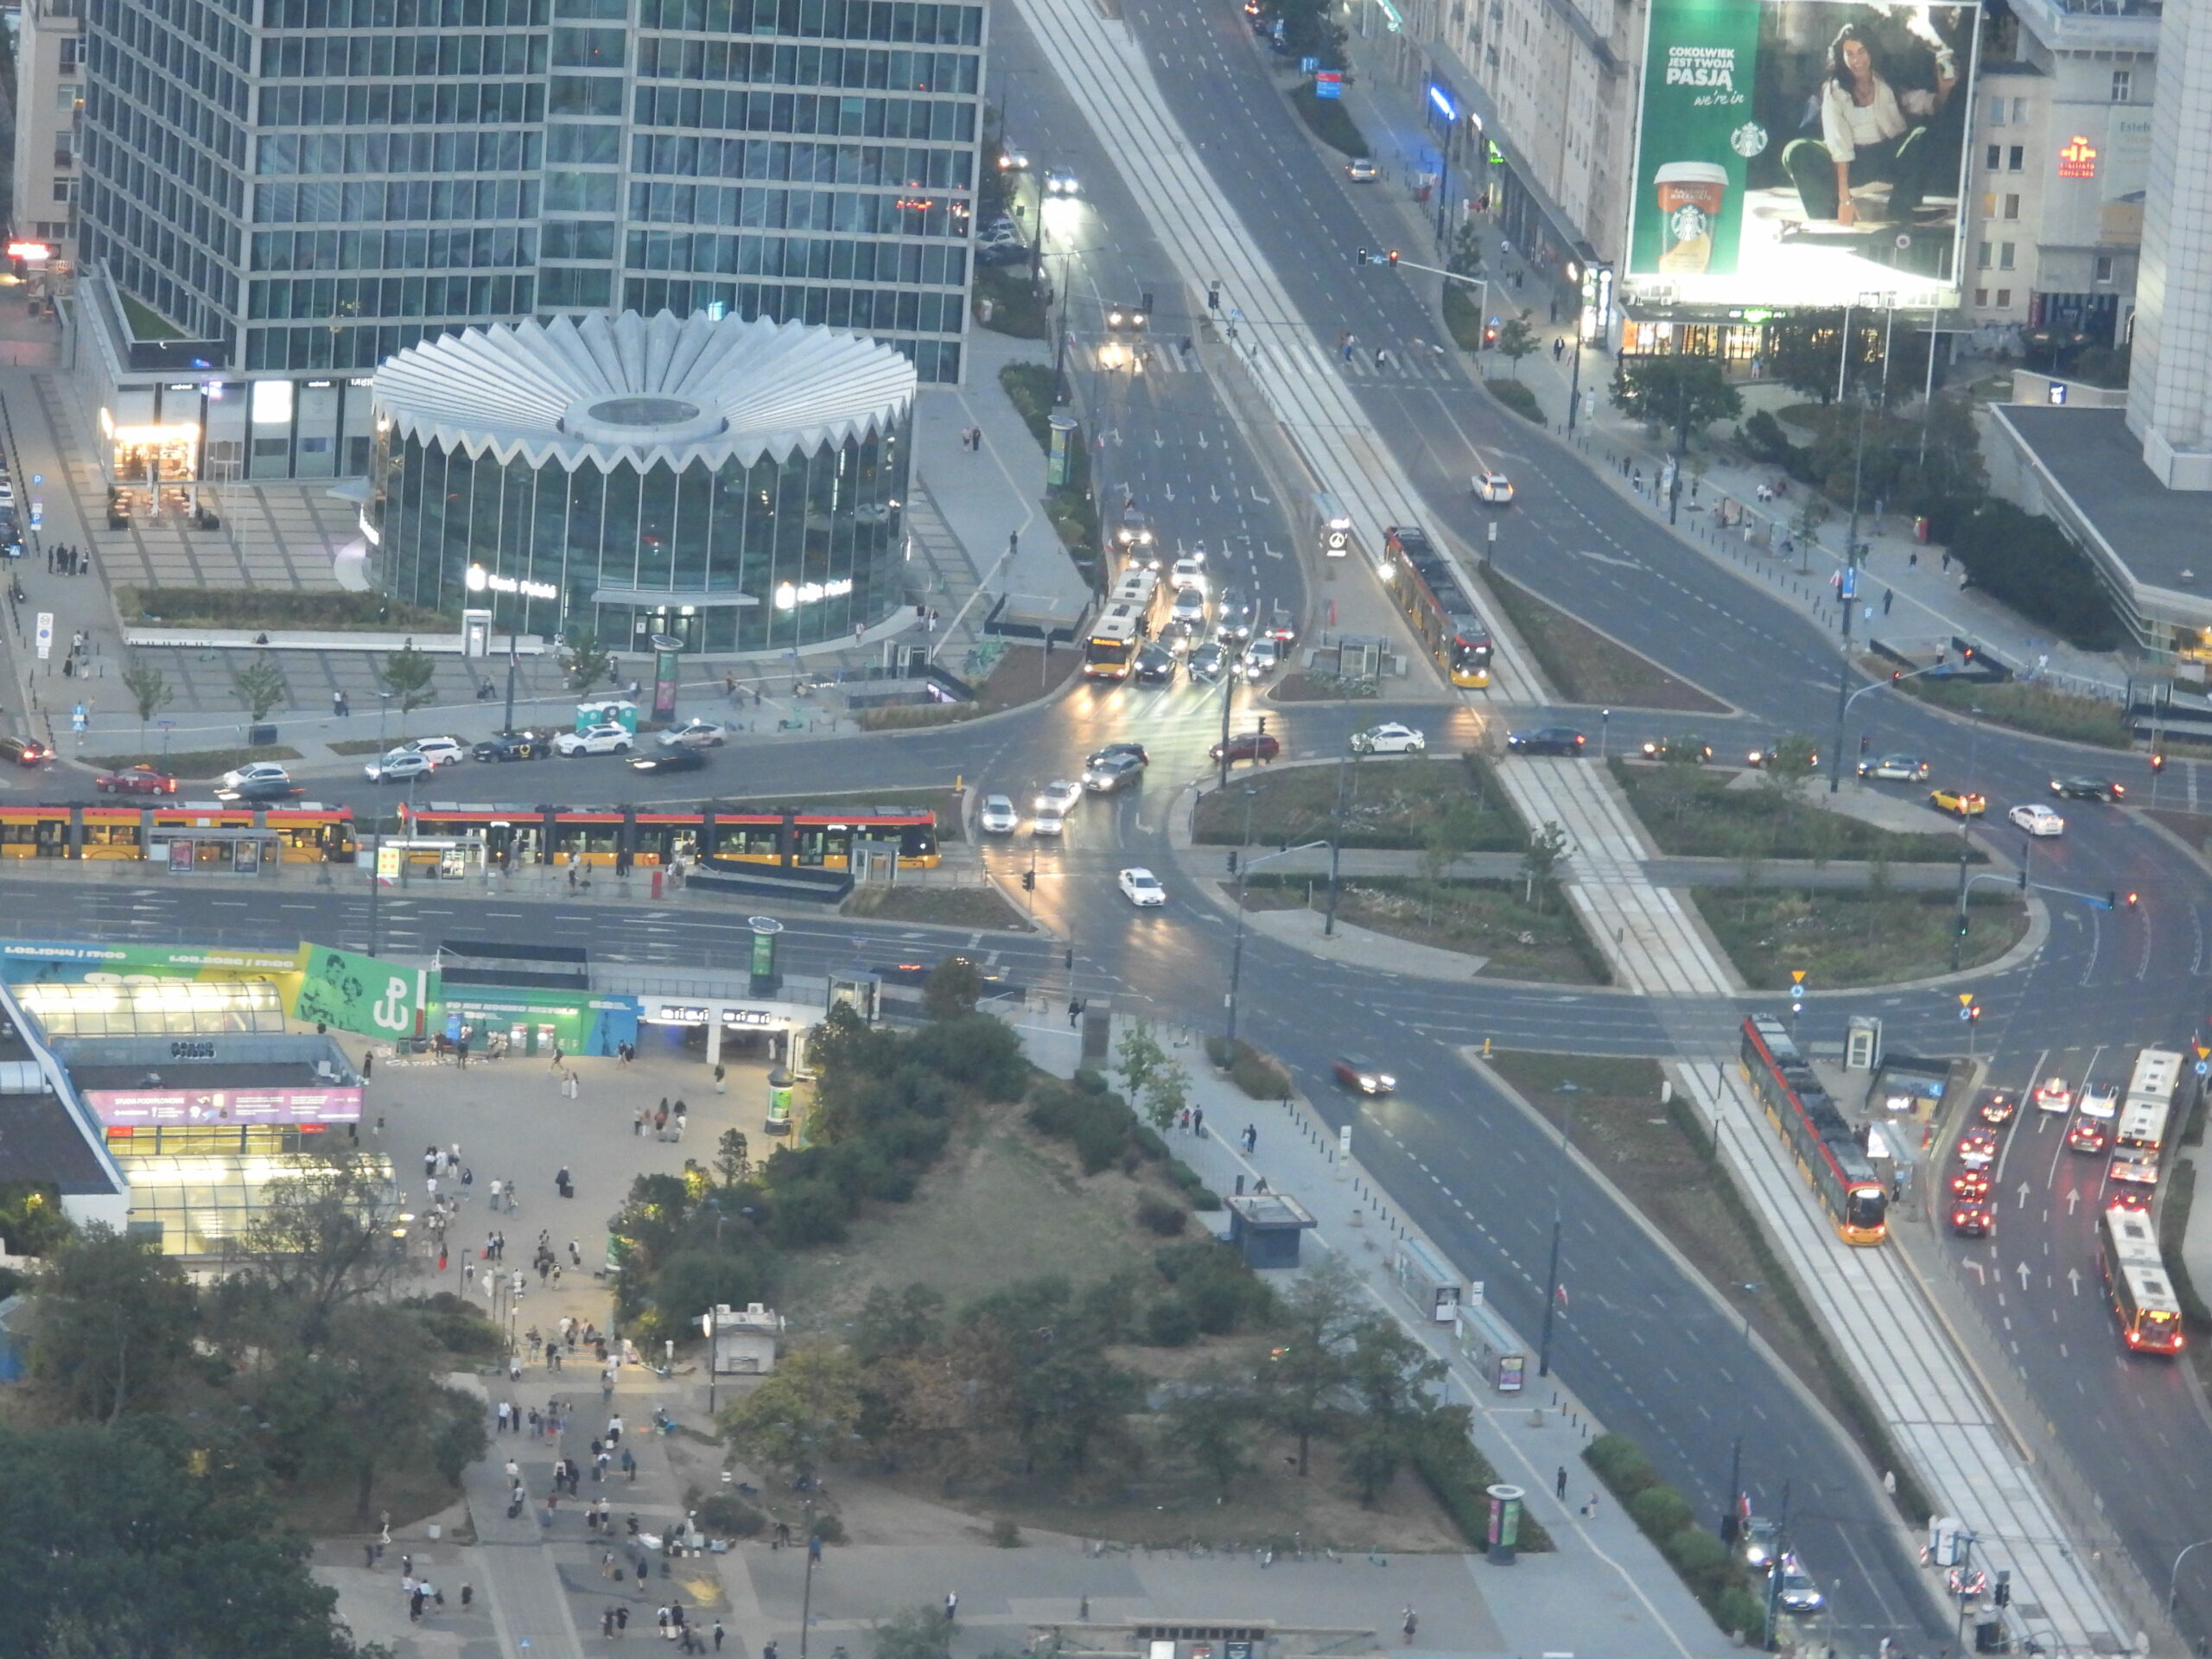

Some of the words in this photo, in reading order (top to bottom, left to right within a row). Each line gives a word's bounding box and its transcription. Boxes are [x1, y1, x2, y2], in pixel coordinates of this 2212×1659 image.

[1669, 47, 1735, 59] COKOLWIEK
[1668, 57, 1693, 67] JEST
[1694, 58, 1735, 72] TWOJĄ
[1666, 67, 1732, 92] PASJĄ
[1694, 89, 1728, 105] we're
[1730, 90, 1744, 105] in
